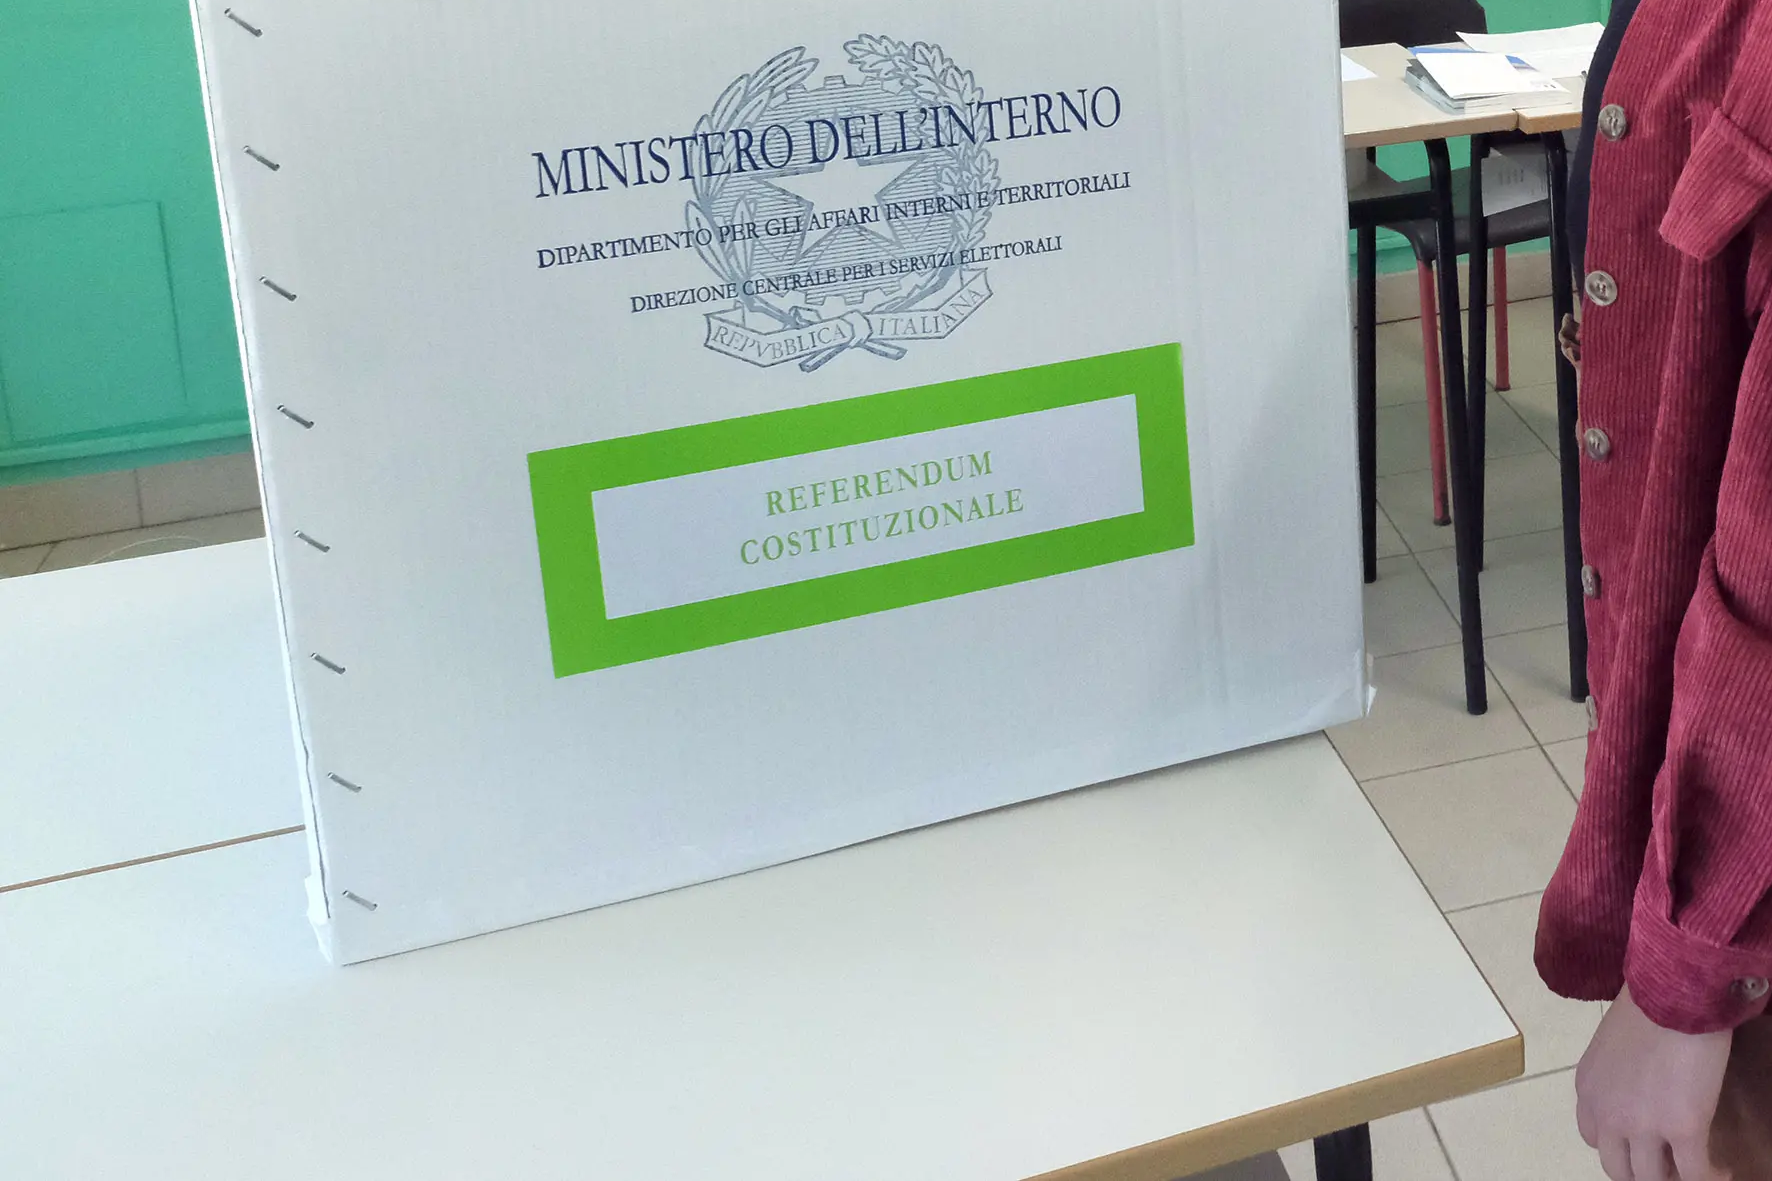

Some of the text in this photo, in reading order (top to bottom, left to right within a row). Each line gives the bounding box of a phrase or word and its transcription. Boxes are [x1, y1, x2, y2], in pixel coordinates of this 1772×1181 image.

[531, 86, 1121, 198] MINISTERO DELL'INTERNO
[537, 171, 1131, 269] DIPARTIMENTO PER GLI AFFARI INTERNI E TERRITORIALI
[630, 236, 1062, 313] DIREZIONE CENTRALE PER I SERVIZI ELETTORALI
[879, 288, 984, 336] ITALIANA
[766, 450, 992, 516] REFERENDUM
[740, 488, 1024, 564] COSTITUZIONALE
